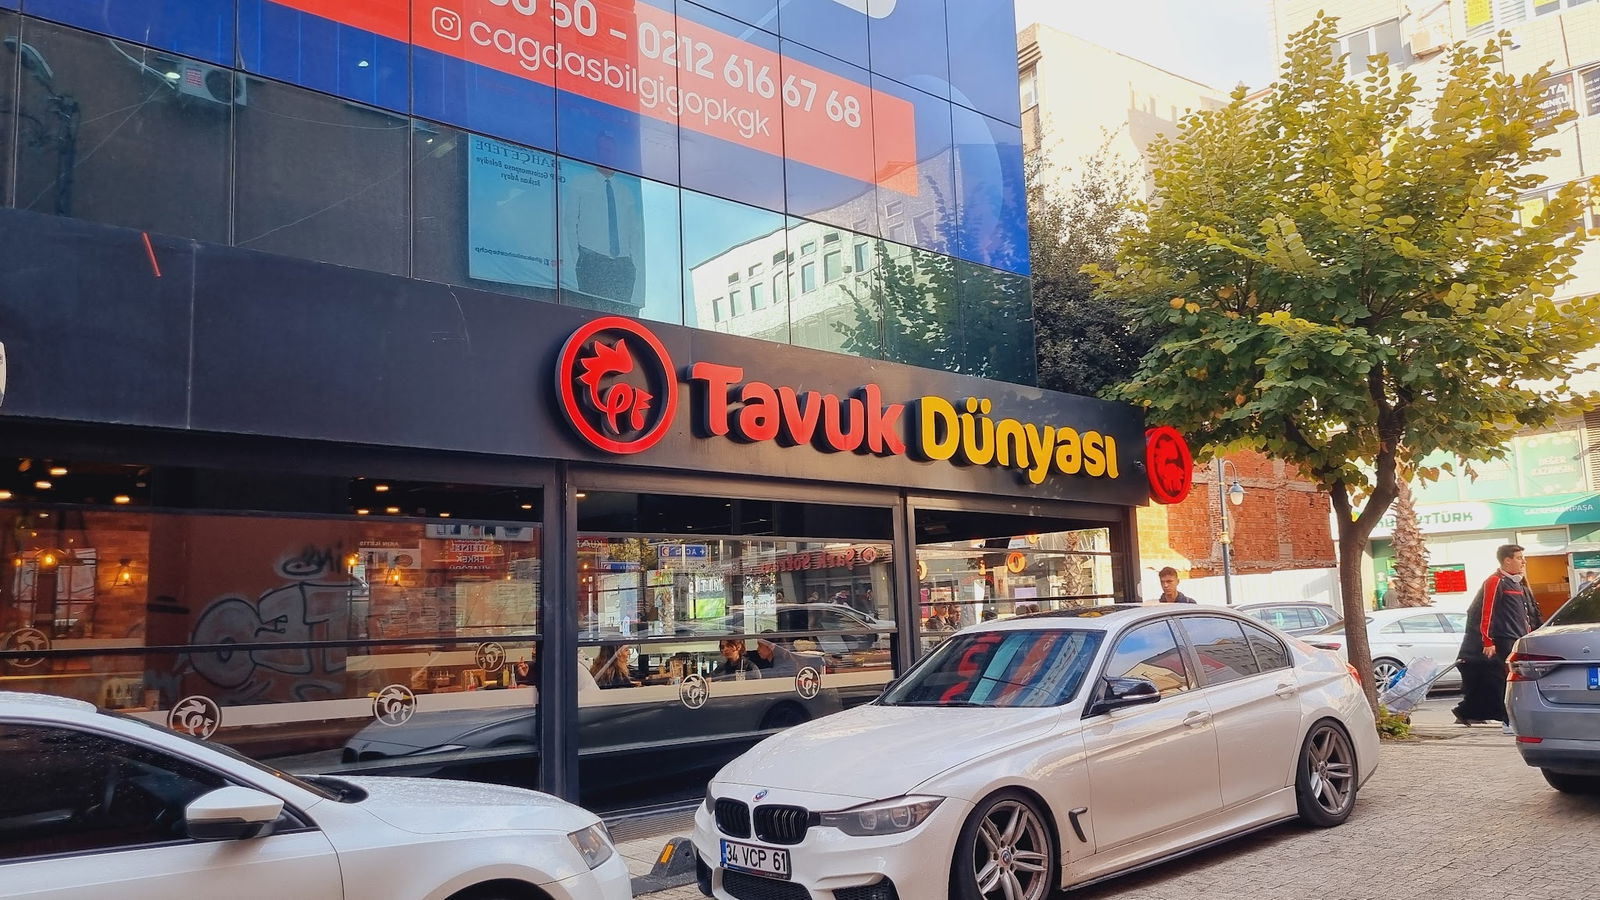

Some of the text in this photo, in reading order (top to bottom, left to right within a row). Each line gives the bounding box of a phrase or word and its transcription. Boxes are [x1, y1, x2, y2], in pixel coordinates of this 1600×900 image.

[469, 20, 770, 138] cagdasbilgigopkgk
[638, 21, 714, 80] 0212
[723, 54, 775, 99] 616
[782, 74, 817, 112] 67
[825, 90, 861, 128] 68
[687, 362, 1120, 485] Tavuk Dünyası
[726, 843, 786, 872] 34 VCP 61
